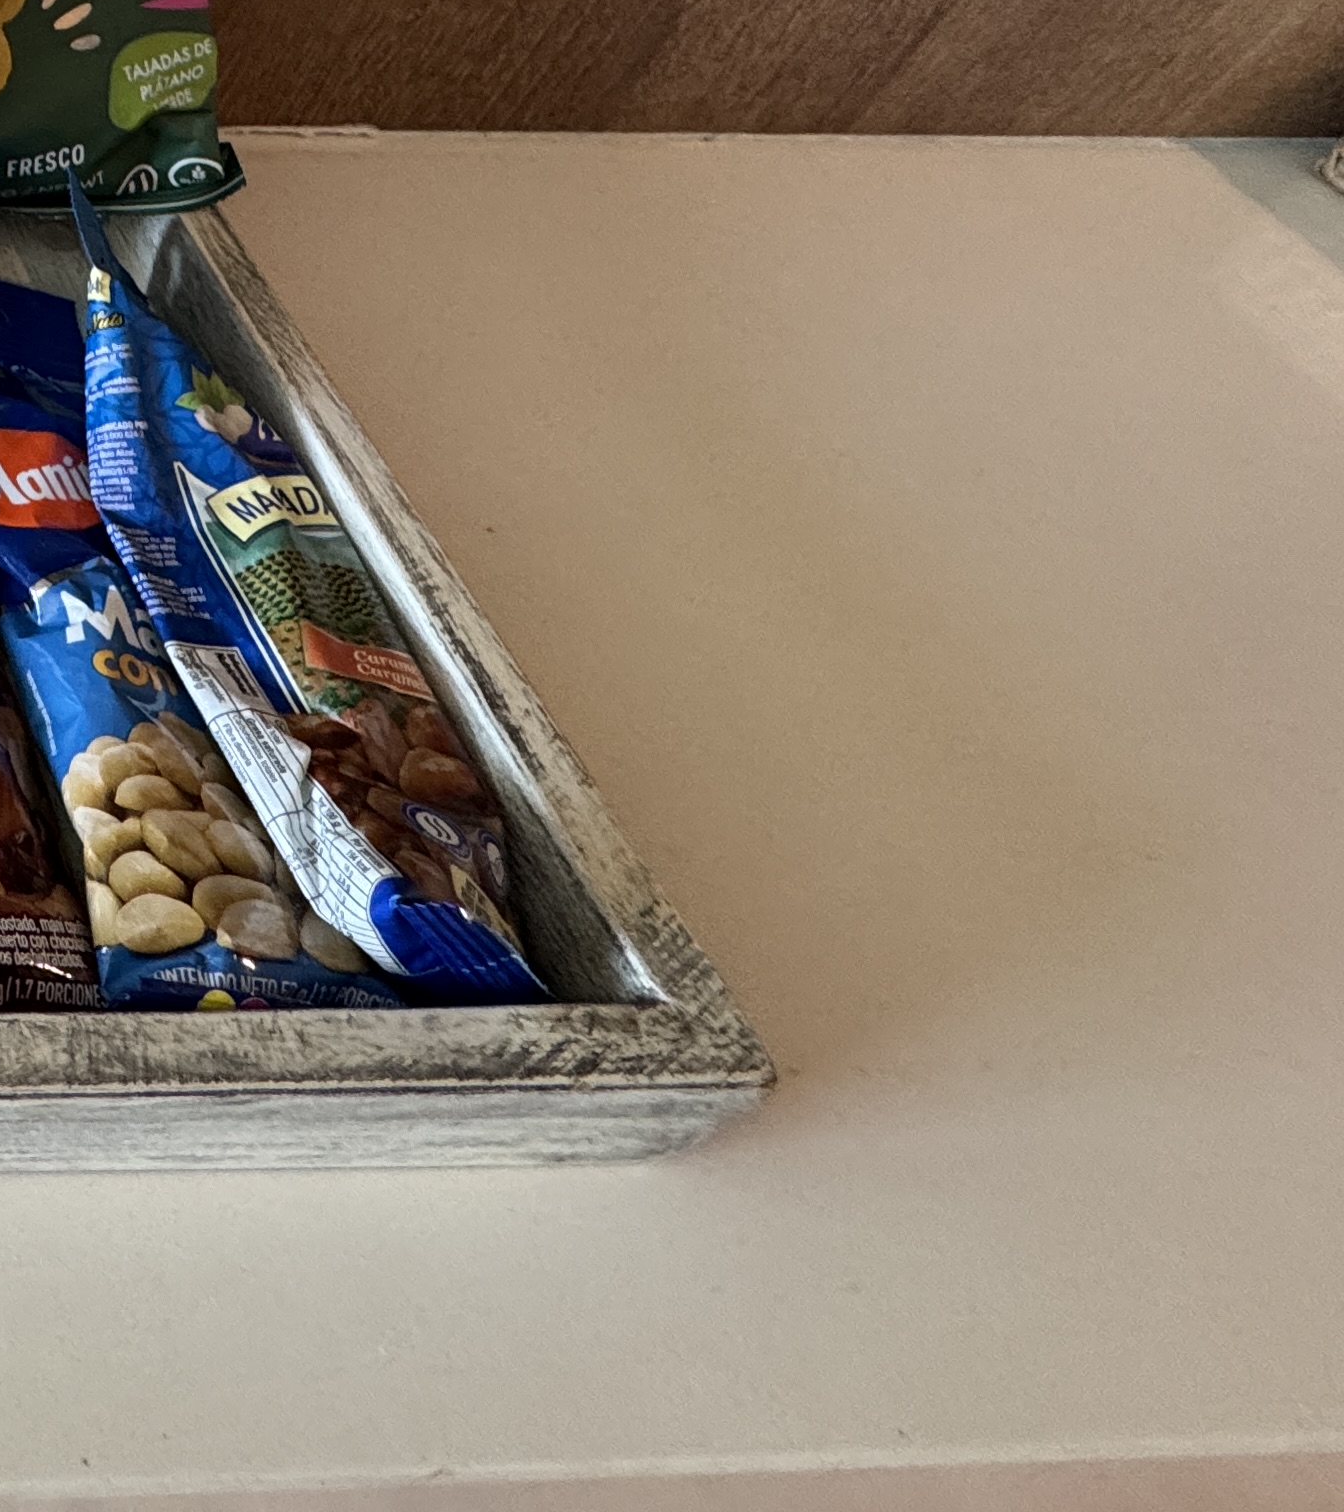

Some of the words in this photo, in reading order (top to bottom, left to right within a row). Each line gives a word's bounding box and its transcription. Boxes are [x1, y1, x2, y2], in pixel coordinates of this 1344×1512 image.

[123, 47, 192, 82] TAJADAS
[194, 39, 212, 59] DE
[7, 144, 86, 178] FRESCO
